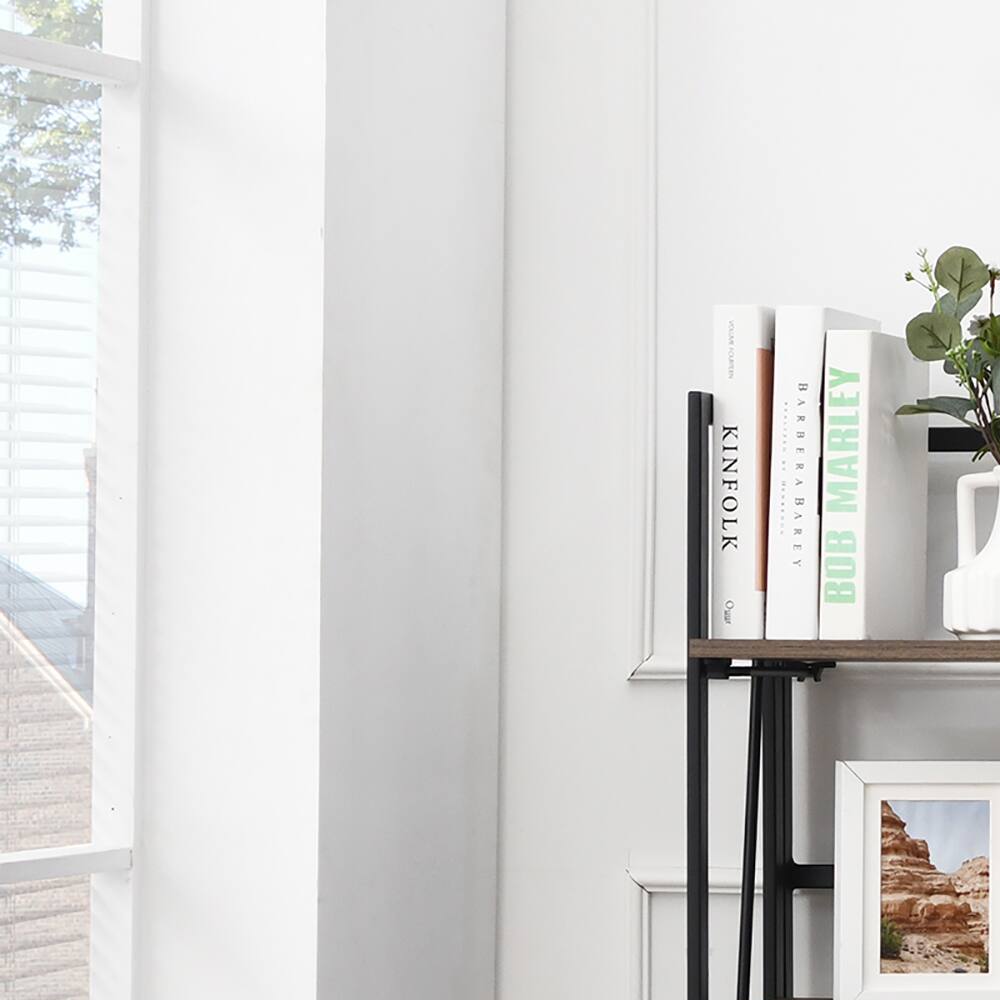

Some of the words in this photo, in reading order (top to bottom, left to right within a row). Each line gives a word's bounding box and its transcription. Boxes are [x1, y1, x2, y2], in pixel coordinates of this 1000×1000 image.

[722, 425, 738, 551] KINFOLK
[826, 367, 861, 513] MARLEY
[824, 530, 857, 604] BOB
